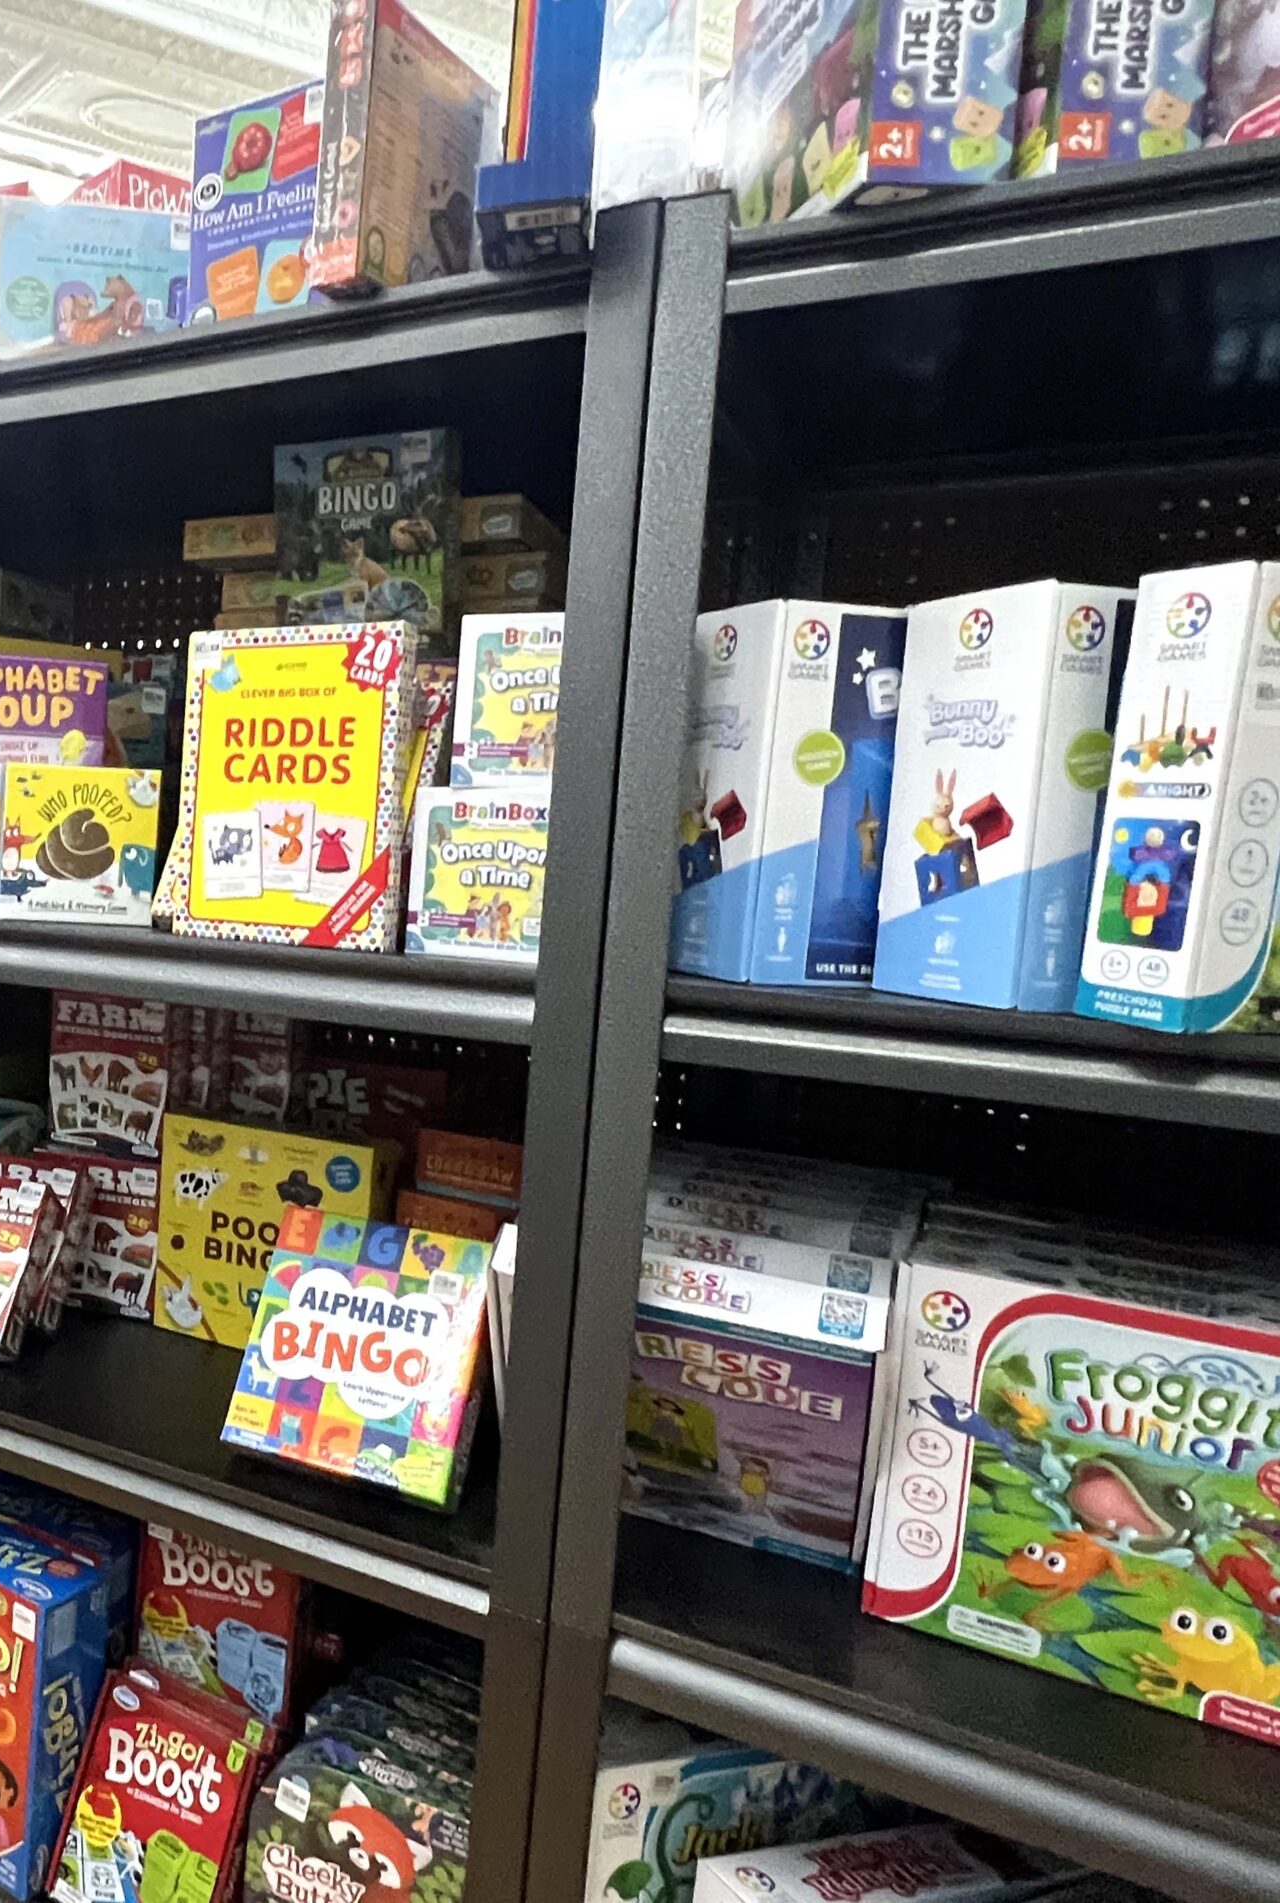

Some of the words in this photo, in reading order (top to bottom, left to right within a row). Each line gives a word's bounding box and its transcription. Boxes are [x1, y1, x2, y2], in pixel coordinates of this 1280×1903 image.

[902, 10, 931, 66] THE
[1093, 0, 1120, 56] THE
[931, 0, 964, 98] MARSH
[1121, 0, 1153, 89] MARS
[879, 126, 903, 160] 2+
[1068, 118, 1093, 151] 2+
[128, 174, 192, 216] PicWi
[193, 209, 225, 232] How
[227, 201, 253, 224] Am
[256, 195, 264, 214] I
[267, 183, 317, 211] Feelin
[72, 243, 133, 258] BEDTIME
[319, 481, 398, 515] BINGO
[340, 517, 373, 532] GAME
[504, 626, 562, 646] Brain
[354, 634, 393, 671] 20
[1157, 650, 1207, 663] GAMES
[349, 664, 385, 686] CARDS
[492, 668, 548, 692] Once
[788, 670, 830, 682] GAMES
[241, 688, 276, 699] CLEVER
[278, 687, 296, 698] BIG
[299, 687, 320, 697] BOX
[323, 686, 338, 697] OF
[512, 697, 526, 713] a
[929, 700, 998, 726] Bunny
[224, 716, 356, 748] RIDDLE
[960, 723, 1004, 750] Boo
[223, 753, 351, 785] CARDS
[806, 761, 832, 772] GAME
[39, 791, 68, 824] WHO
[72, 782, 133, 826] POOPED?
[454, 801, 548, 822] BrainBox
[442, 842, 494, 864] Once
[461, 869, 474, 886] a
[477, 866, 531, 889] Time
[1096, 989, 1163, 1010] PRESCHOOL
[1131, 1007, 1163, 1022] GAME
[211, 1211, 279, 1241] POO
[367, 1226, 401, 1266] G
[642, 1262, 719, 1288] RESS
[655, 1281, 746, 1311] CODE
[298, 1286, 438, 1337] ALPHABET
[914, 1338, 968, 1357] GAMES
[916, 1328, 968, 1347] SMART
[272, 1320, 430, 1387] BINGO
[638, 1332, 787, 1385] RESS
[343, 1380, 365, 1392] Learn
[685, 1365, 836, 1418] CODE
[358, 1396, 388, 1410] Letters!
[919, 1436, 941, 1454] 5+
[1066, 1395, 1256, 1471] Junior
[135, 1722, 205, 1772] Zingo!
[672, 1812, 764, 1865] Jack
[266, 1845, 365, 1900] Cheeky
